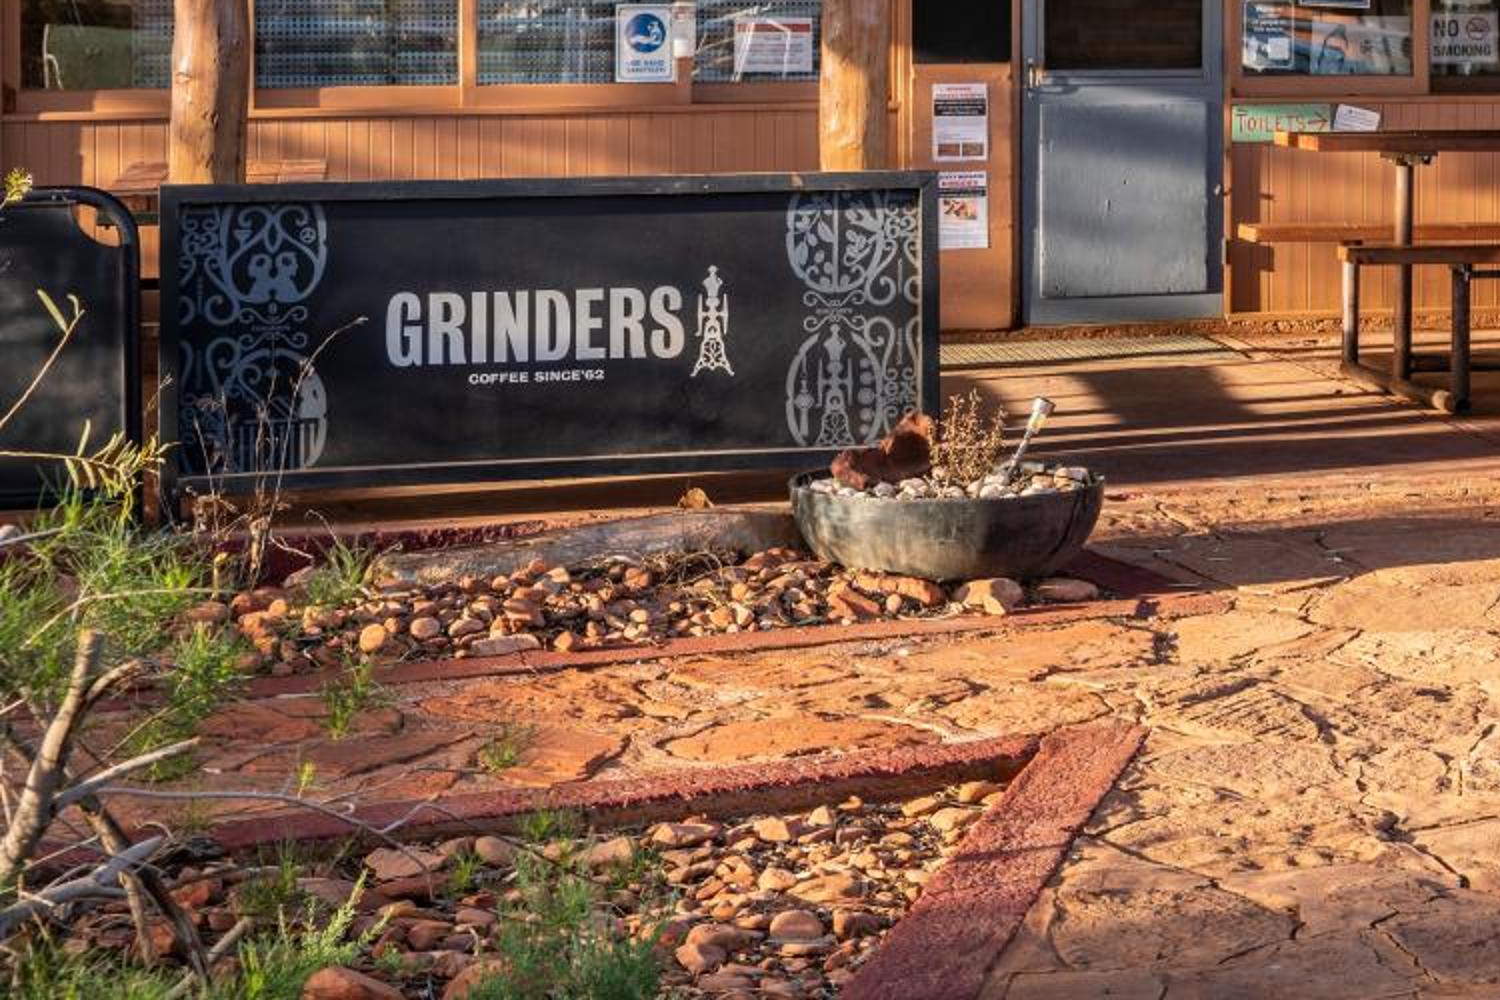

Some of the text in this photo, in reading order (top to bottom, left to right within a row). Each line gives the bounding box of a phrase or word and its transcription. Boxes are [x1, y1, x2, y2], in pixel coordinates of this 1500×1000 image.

[1433, 19, 1459, 38] NO
[1433, 44, 1492, 57] SMOKING
[385, 285, 686, 367] GRINDERS
[468, 372, 529, 385] COFFEE
